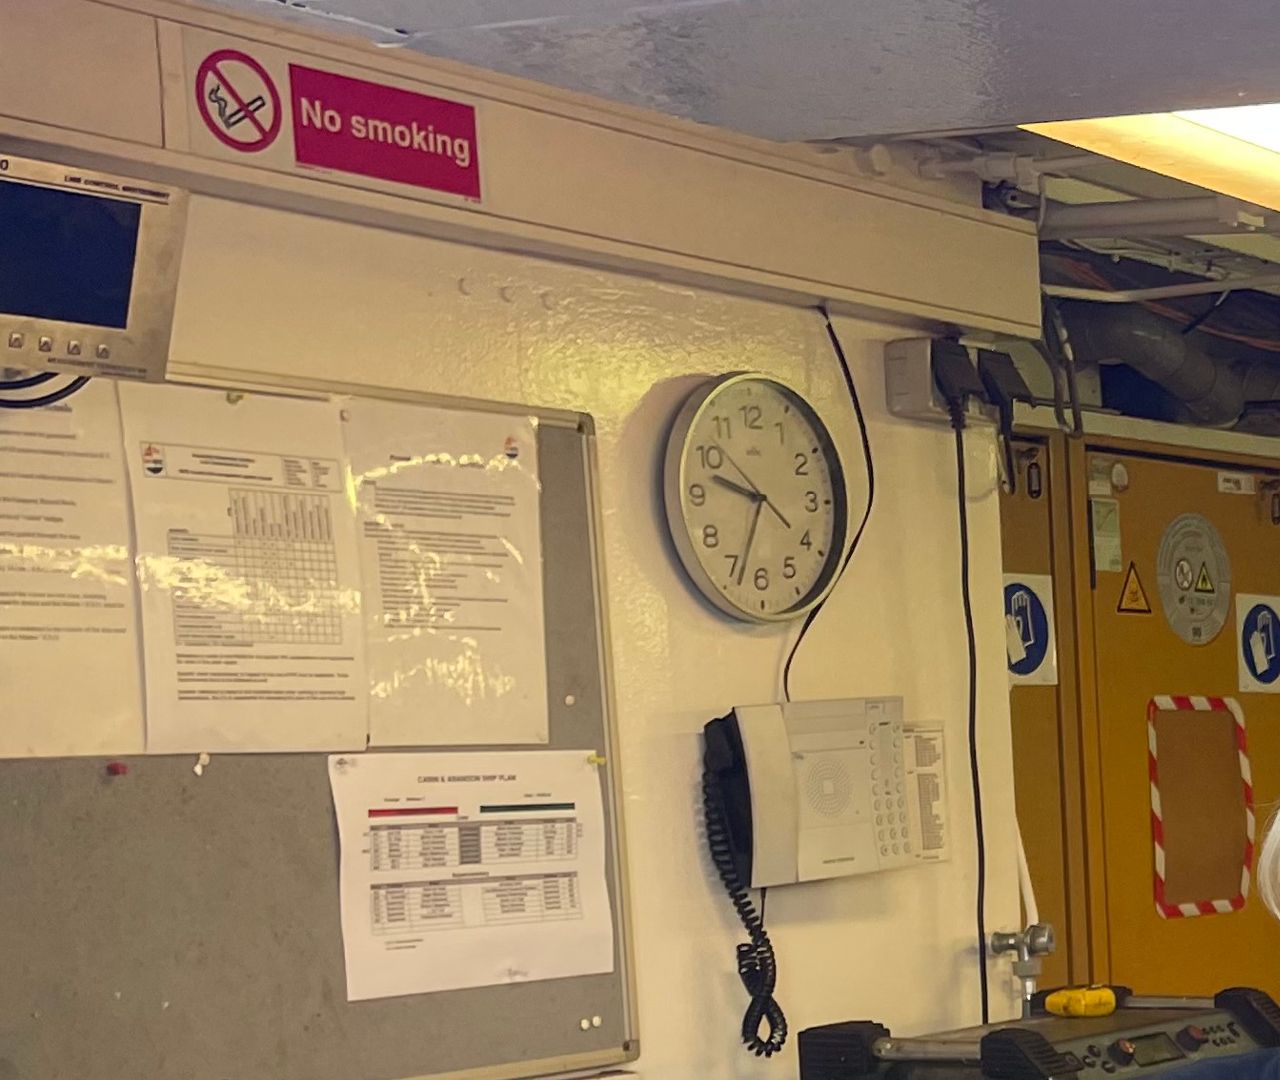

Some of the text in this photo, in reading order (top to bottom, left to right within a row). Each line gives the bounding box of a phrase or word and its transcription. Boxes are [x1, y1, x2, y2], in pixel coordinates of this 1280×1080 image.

[300, 97, 470, 168] No smoking
[712, 416, 732, 439] 11
[740, 405, 764, 430] 12
[775, 422, 785, 445] 1
[696, 445, 723, 469] 10
[794, 453, 809, 476] 2
[689, 483, 706, 507] 9
[804, 490, 818, 512] 3
[703, 524, 719, 548] 8
[799, 529, 812, 550] 4
[724, 554, 738, 578] 7
[783, 556, 796, 579] 5
[754, 568, 769, 591] 6
